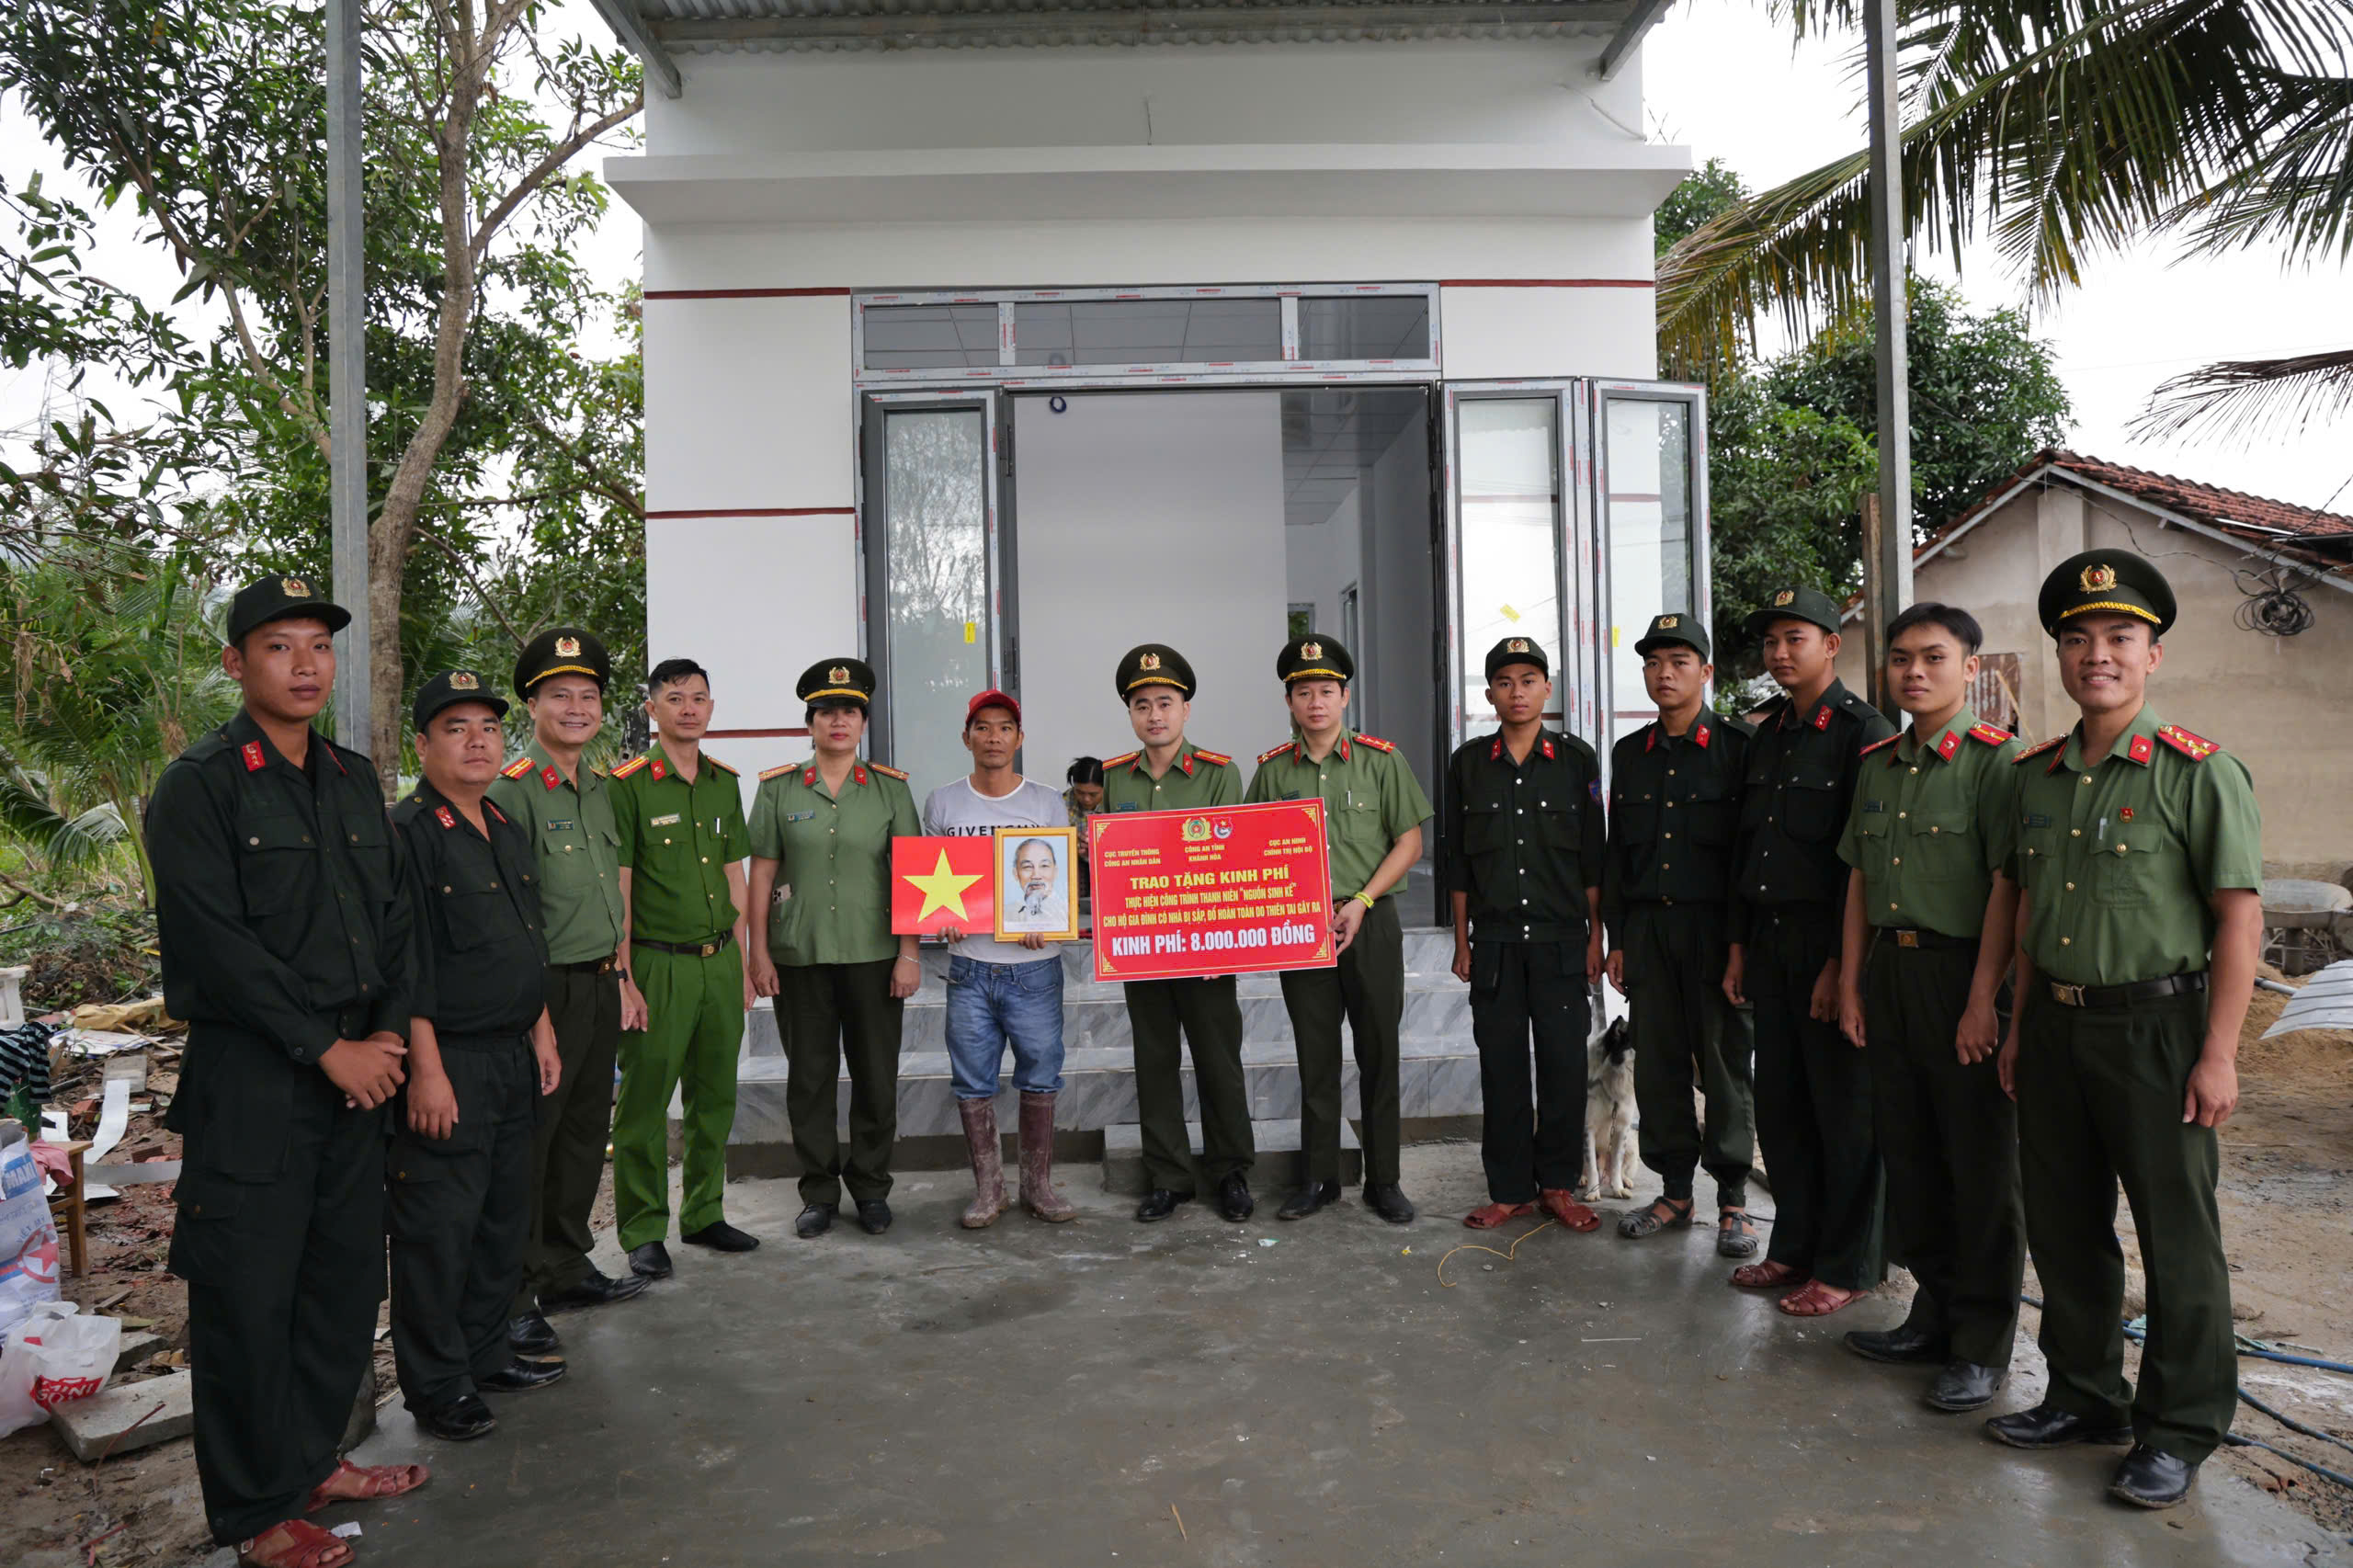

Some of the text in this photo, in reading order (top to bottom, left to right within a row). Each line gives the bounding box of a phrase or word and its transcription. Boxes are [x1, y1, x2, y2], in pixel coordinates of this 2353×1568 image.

[947, 824, 1040, 837] GIVE
[1141, 847, 1160, 856] THÔNG
[1185, 845, 1200, 853] CÔNG
[1211, 843, 1225, 851] TỈNH
[1264, 847, 1281, 857] CHÍNH
[1131, 858, 1148, 866] NHÂN
[1188, 854, 1208, 862] KHÁNH
[1130, 864, 1290, 890] TRAO TẶNG KINH PHÍ
[1125, 897, 1142, 910] THỰC
[1142, 893, 1158, 910] HIỆN
[1160, 892, 1178, 906] CÔNG
[1179, 892, 1199, 905] TRÌNH
[1199, 891, 1222, 903] THANH
[1222, 888, 1239, 902] NIÊN
[1267, 886, 1284, 899] SINH
[1103, 915, 1117, 927] CHO
[1118, 913, 1128, 929] HỘ
[1129, 915, 1140, 926] GIA
[1168, 909, 1183, 924] NHÀ
[1184, 911, 1192, 925] BỊ
[1218, 906, 1236, 920] HOÀN
[1237, 904, 1255, 918] TOÀN
[1256, 905, 1266, 916] DO
[1266, 903, 1286, 916] THIÊN
[1286, 903, 1297, 915] TAI
[1297, 900, 1311, 914] GÂY
[1312, 902, 1321, 912] RA
[1112, 919, 1315, 956] KINH PHÍ: 8.000.000 ĐỒNG
